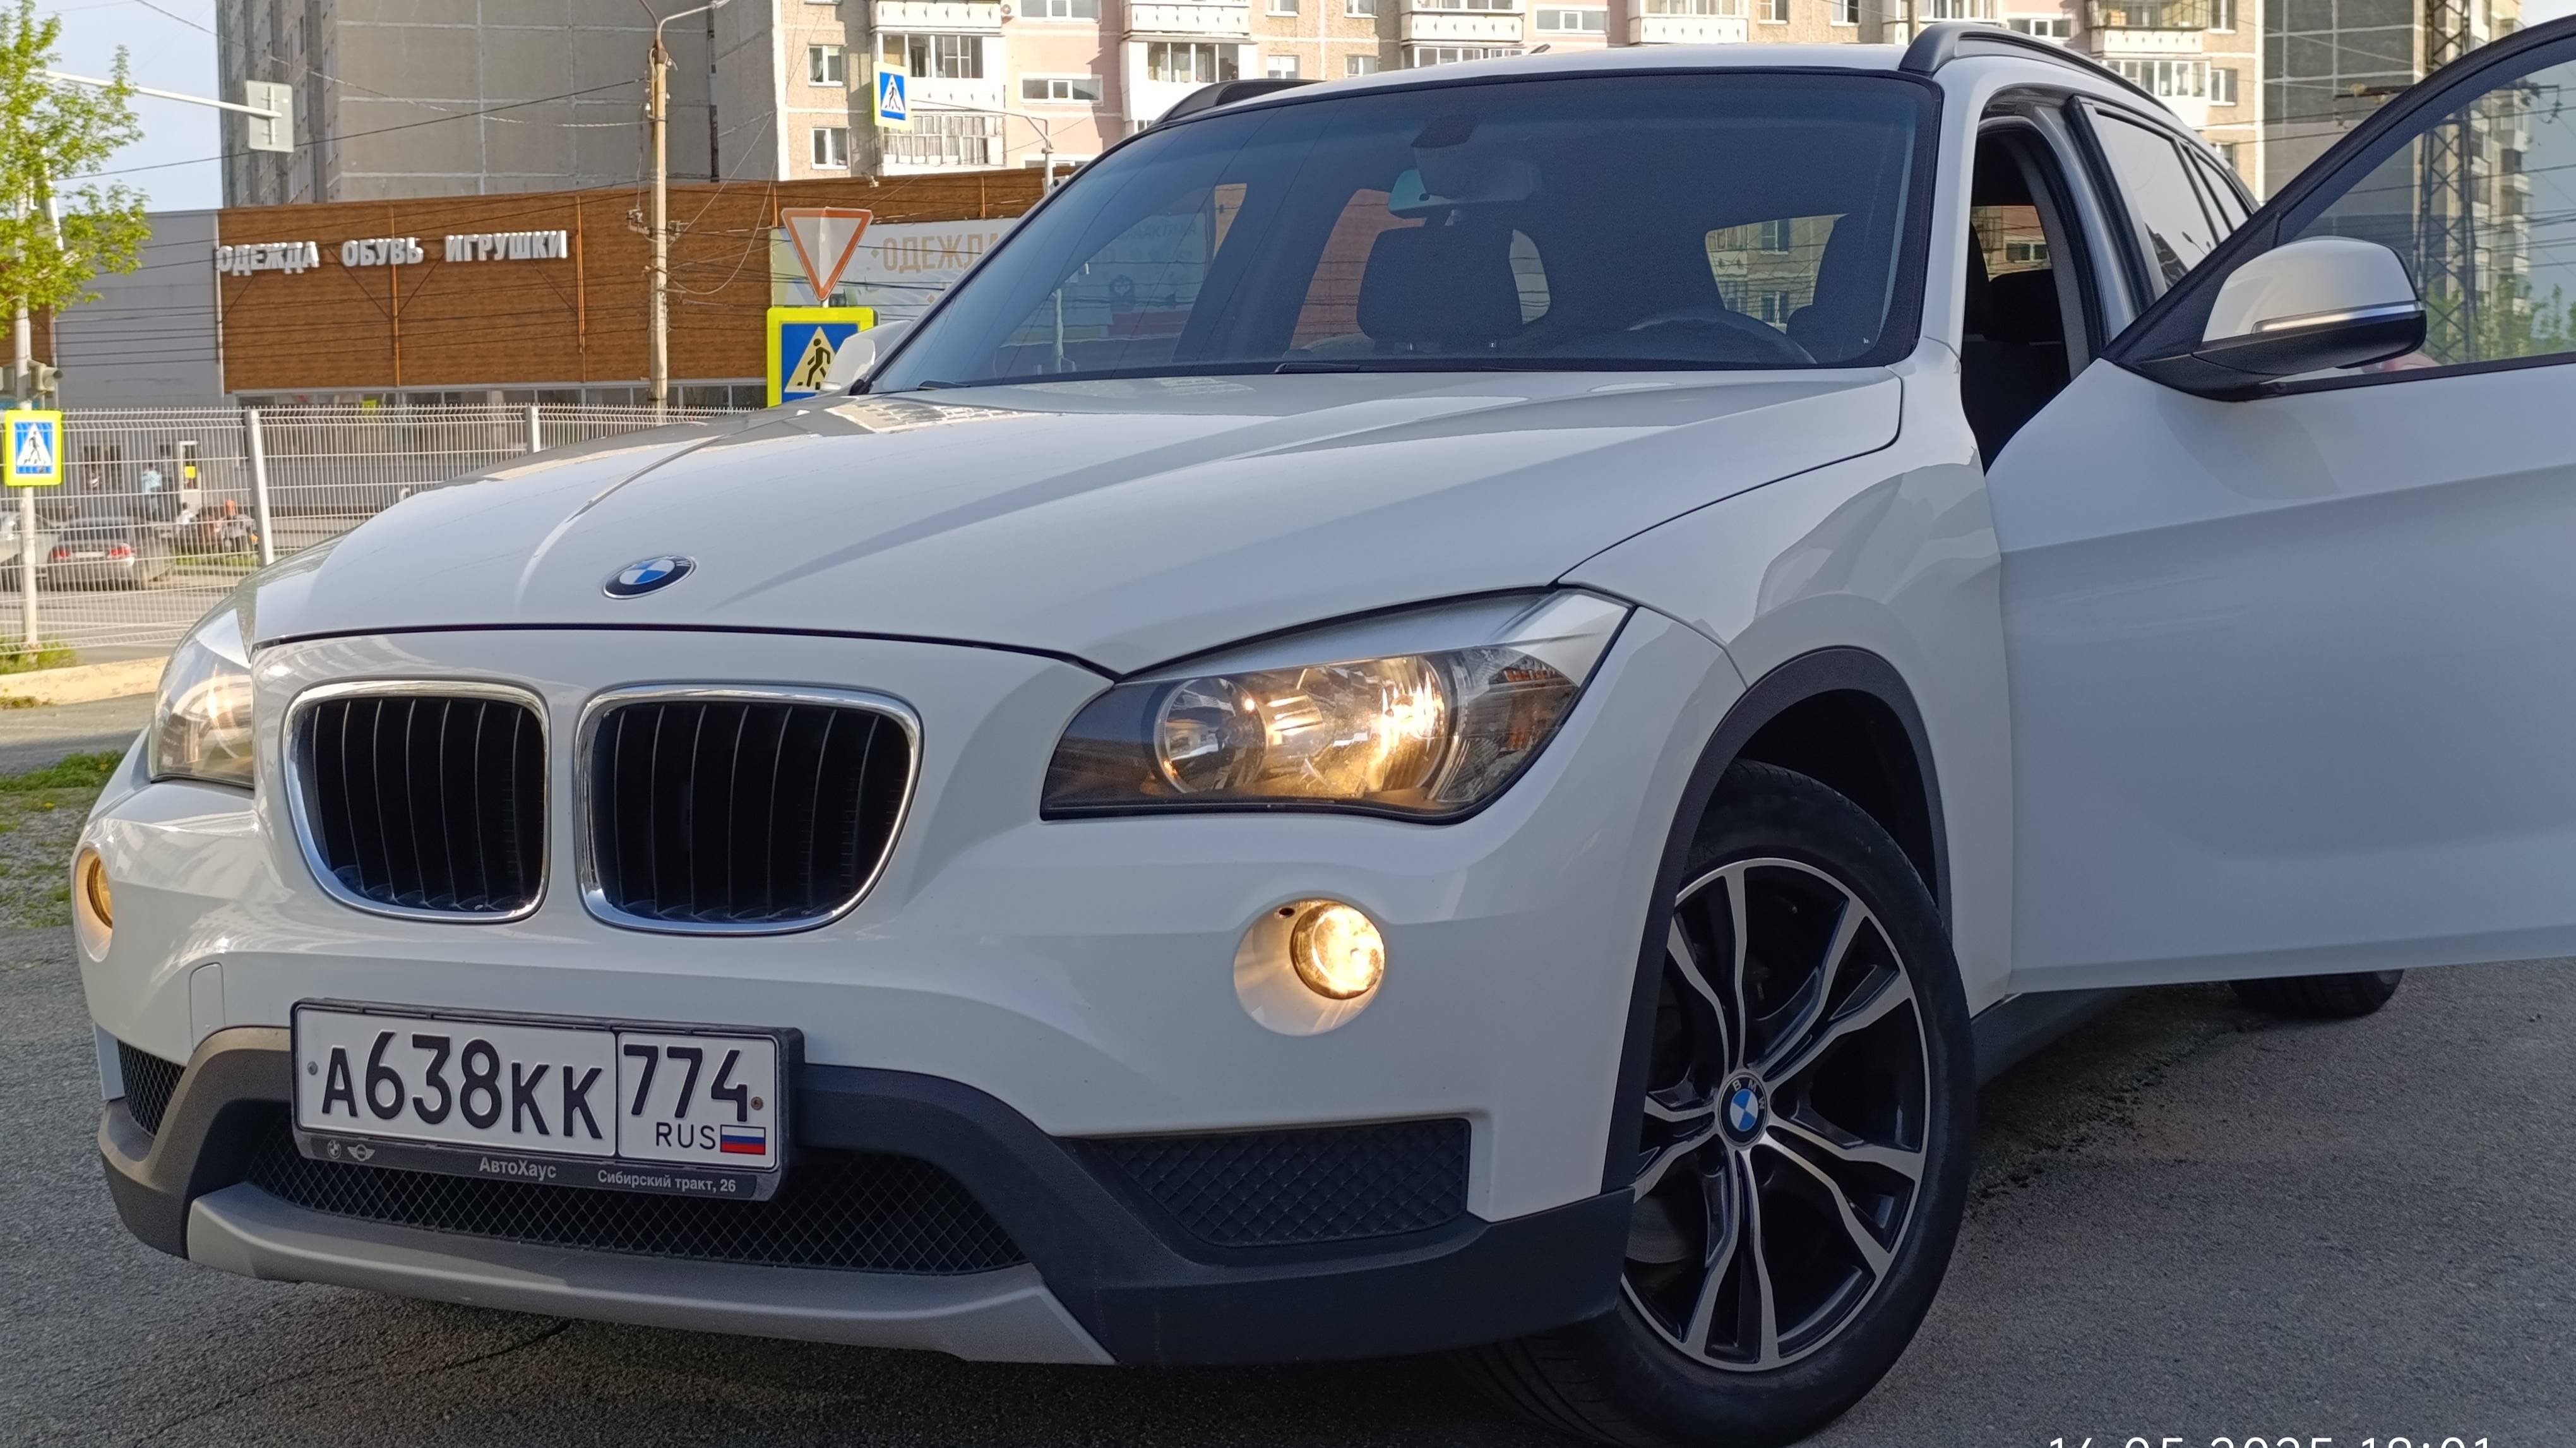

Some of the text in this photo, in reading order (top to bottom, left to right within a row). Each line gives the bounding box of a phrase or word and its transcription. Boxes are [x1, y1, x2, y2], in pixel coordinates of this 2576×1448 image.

[217, 230, 567, 276] ОДЕЖДА ОБУВЬ ИГРУШКИ
[321, 1031, 748, 1140] А638КК 774
[1732, 1079, 1765, 1110] BMW
[655, 1122, 717, 1151] RUS
[479, 1157, 557, 1182] АвтоХаус
[597, 1170, 736, 1194] Сибирский тракт, 26
